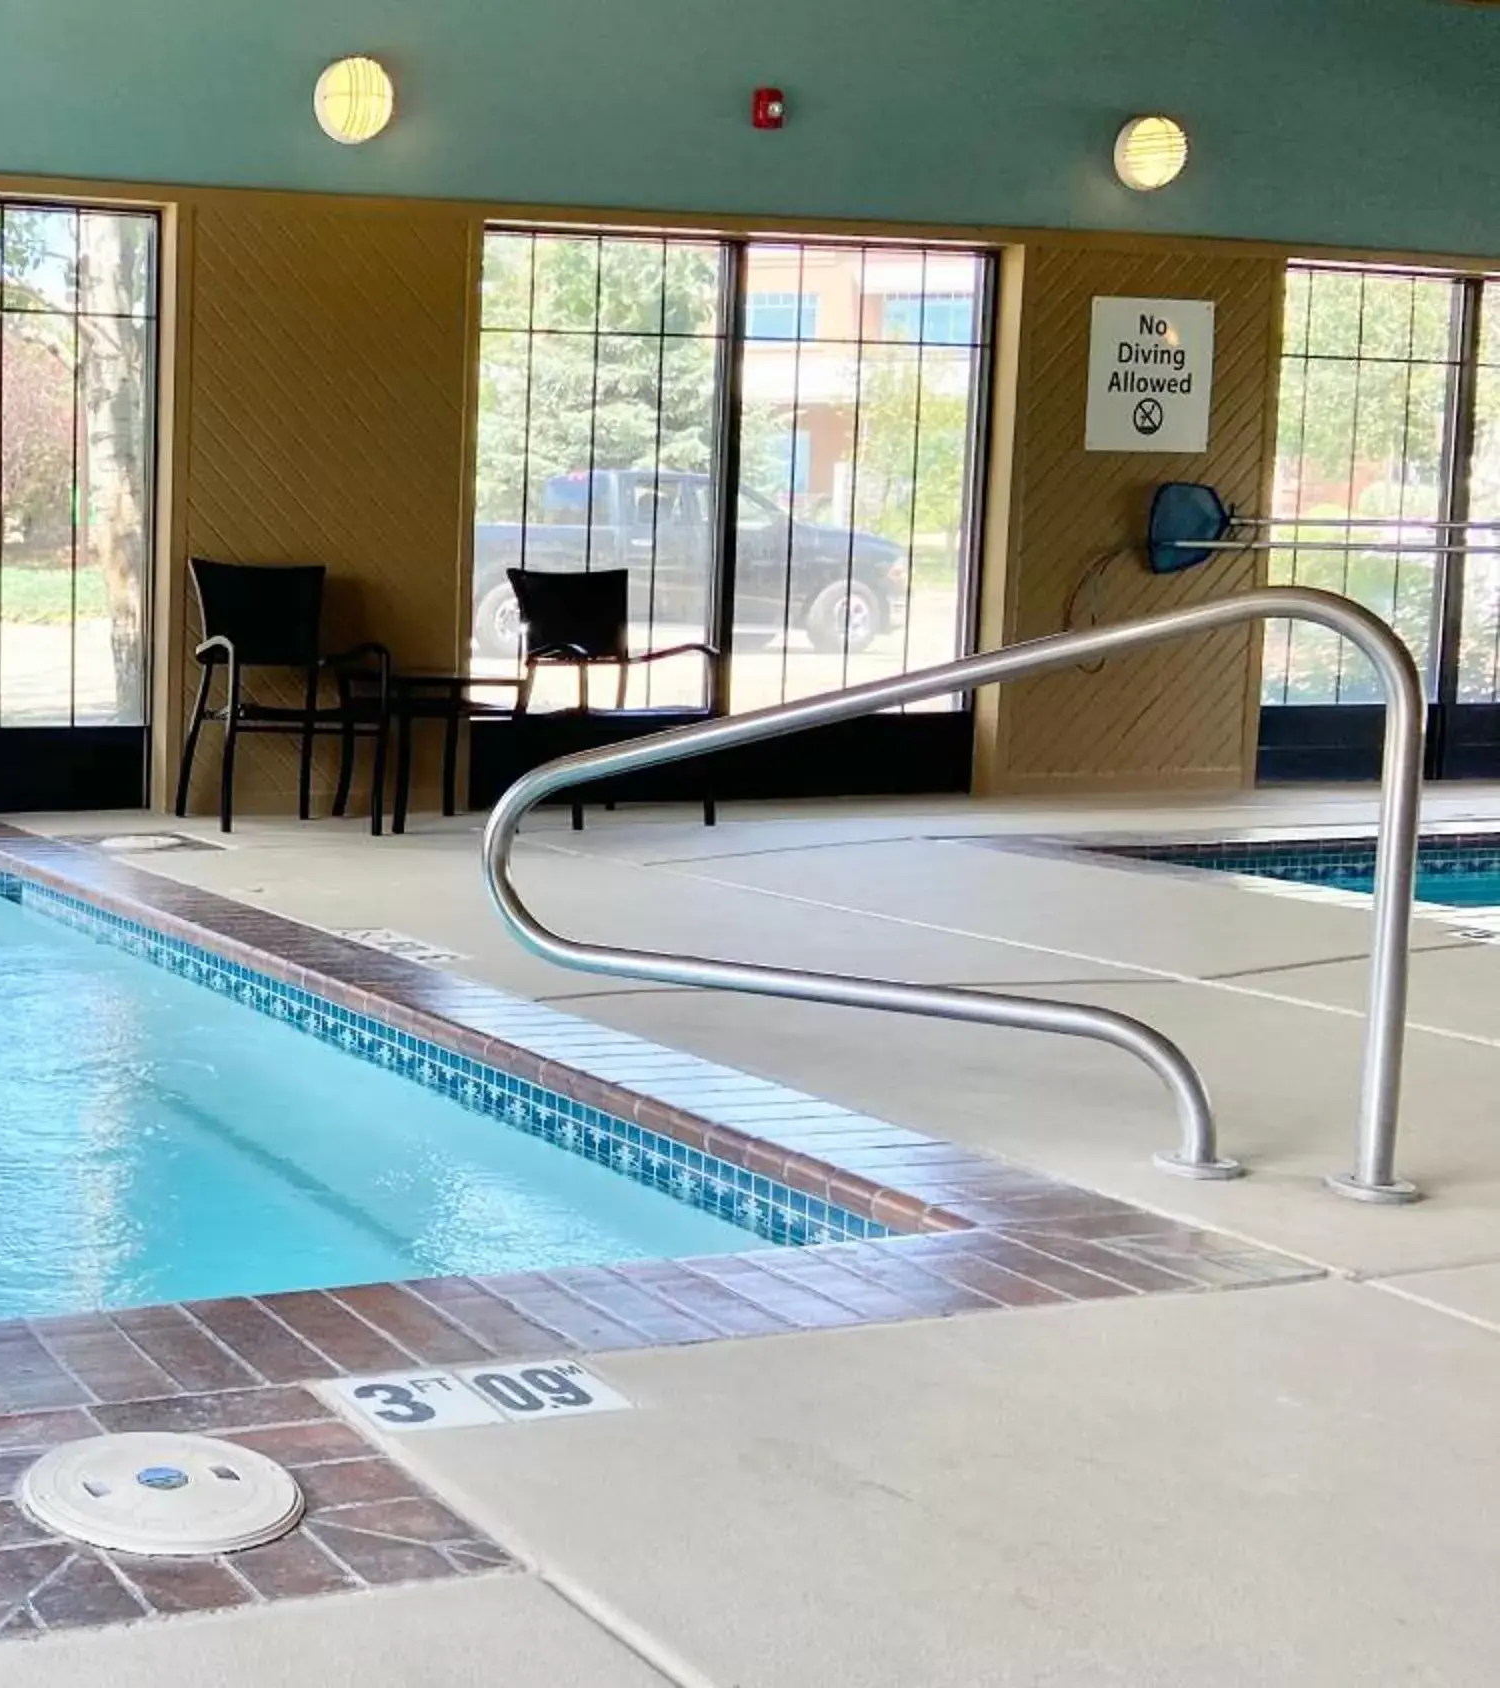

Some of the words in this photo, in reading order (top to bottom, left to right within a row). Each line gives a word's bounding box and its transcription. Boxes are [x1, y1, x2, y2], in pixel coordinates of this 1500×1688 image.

[1139, 314, 1167, 335] No
[1118, 342, 1185, 371] Diving
[1108, 371, 1192, 394] Allowed
[353, 1383, 436, 1423] 3
[408, 1376, 453, 1394] FT
